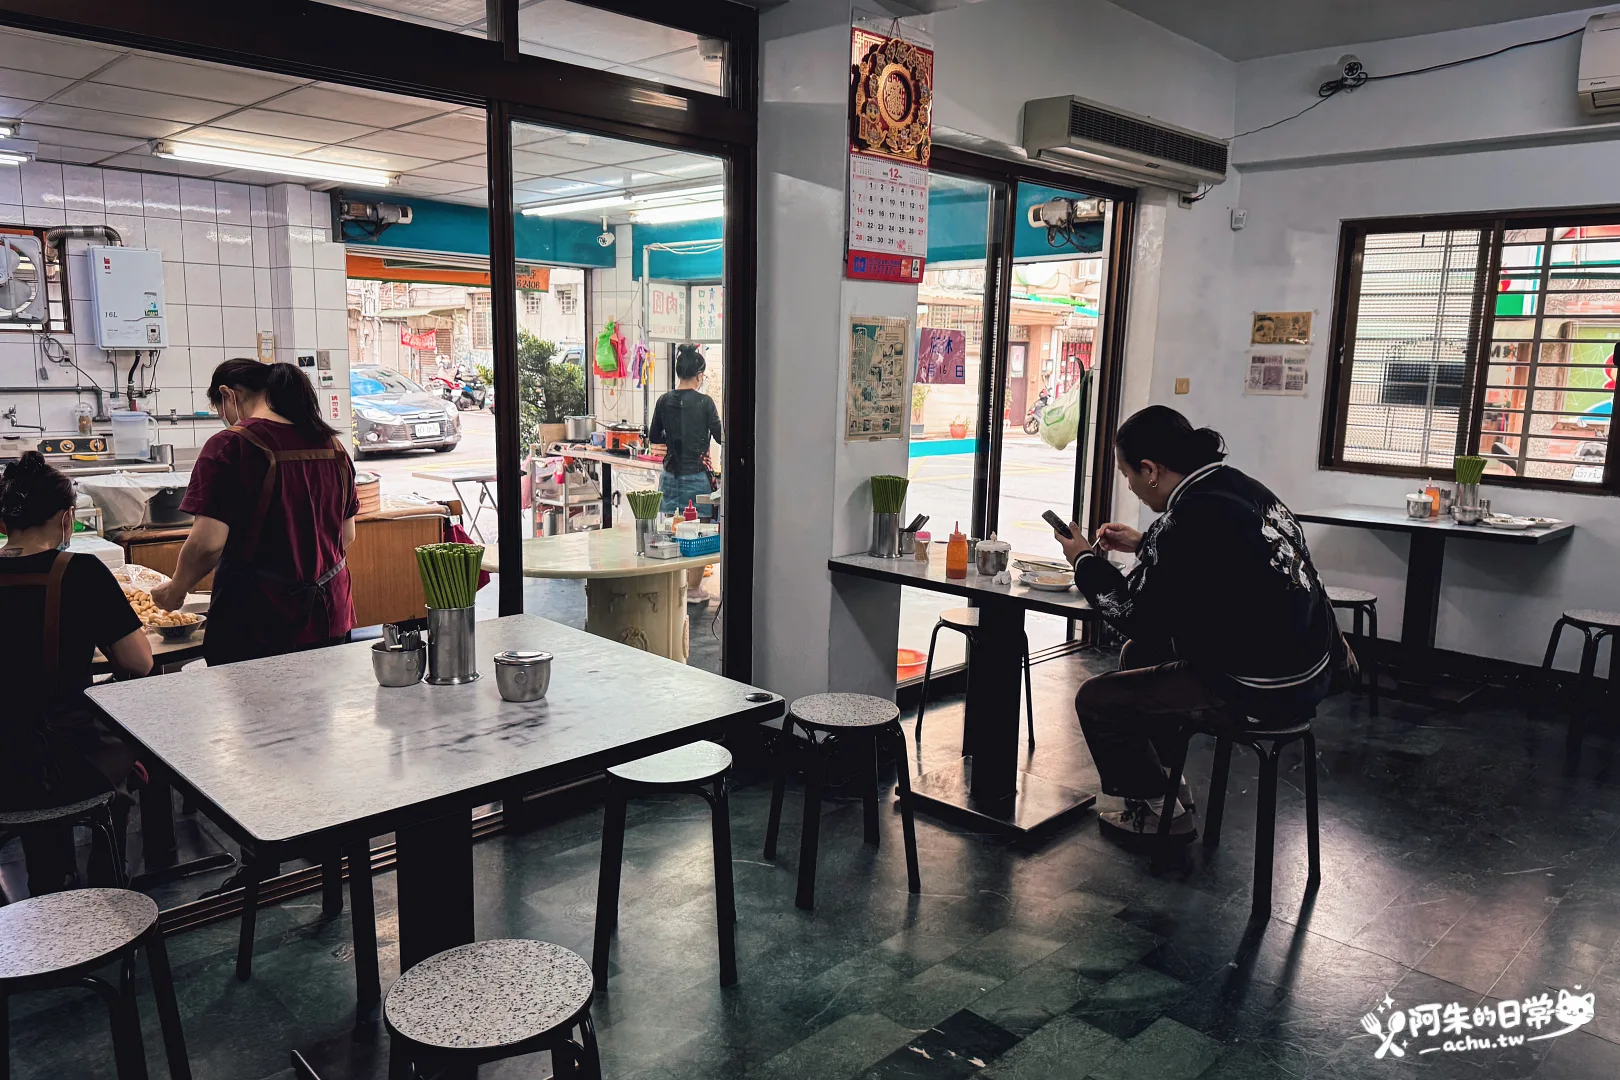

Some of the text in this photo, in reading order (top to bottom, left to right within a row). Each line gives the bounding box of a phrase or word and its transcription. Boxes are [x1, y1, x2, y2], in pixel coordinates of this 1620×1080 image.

[889, 168, 898, 178] 12
[940, 364, 947, 374] 16
[956, 366, 963, 377] 日
